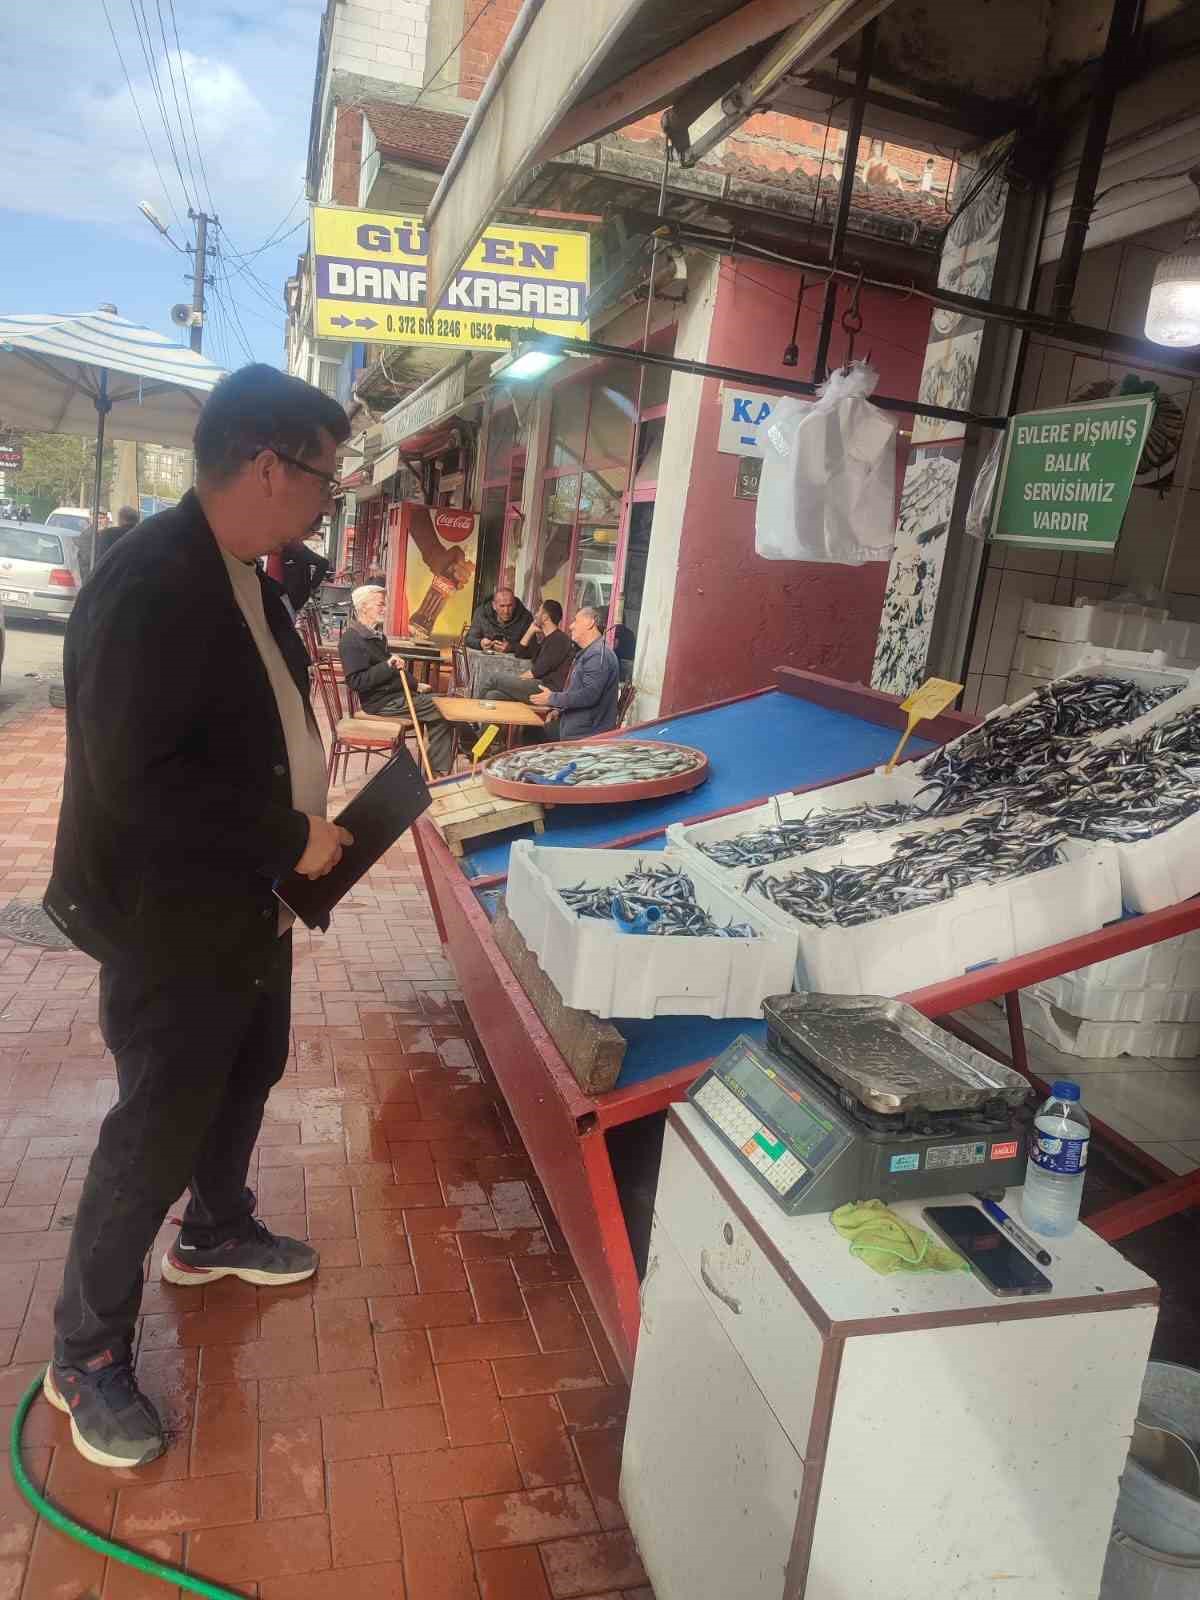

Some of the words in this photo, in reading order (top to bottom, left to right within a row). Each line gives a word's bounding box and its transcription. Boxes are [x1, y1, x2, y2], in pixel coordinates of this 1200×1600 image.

[356, 221, 558, 270] GÜEN
[448, 277, 578, 316] KASABI
[398, 316, 416, 335] 372
[437, 319, 460, 338] 2246
[470, 322, 493, 341] 0542
[1016, 423, 1072, 445] EVLERE
[1073, 415, 1137, 447] PİŞMİŞ
[1044, 452, 1092, 473] BALIK
[1023, 477, 1116, 503] SERVİSİMİZ
[437, 513, 473, 529] Coca-Cola
[1033, 510, 1089, 532] VARDIR
